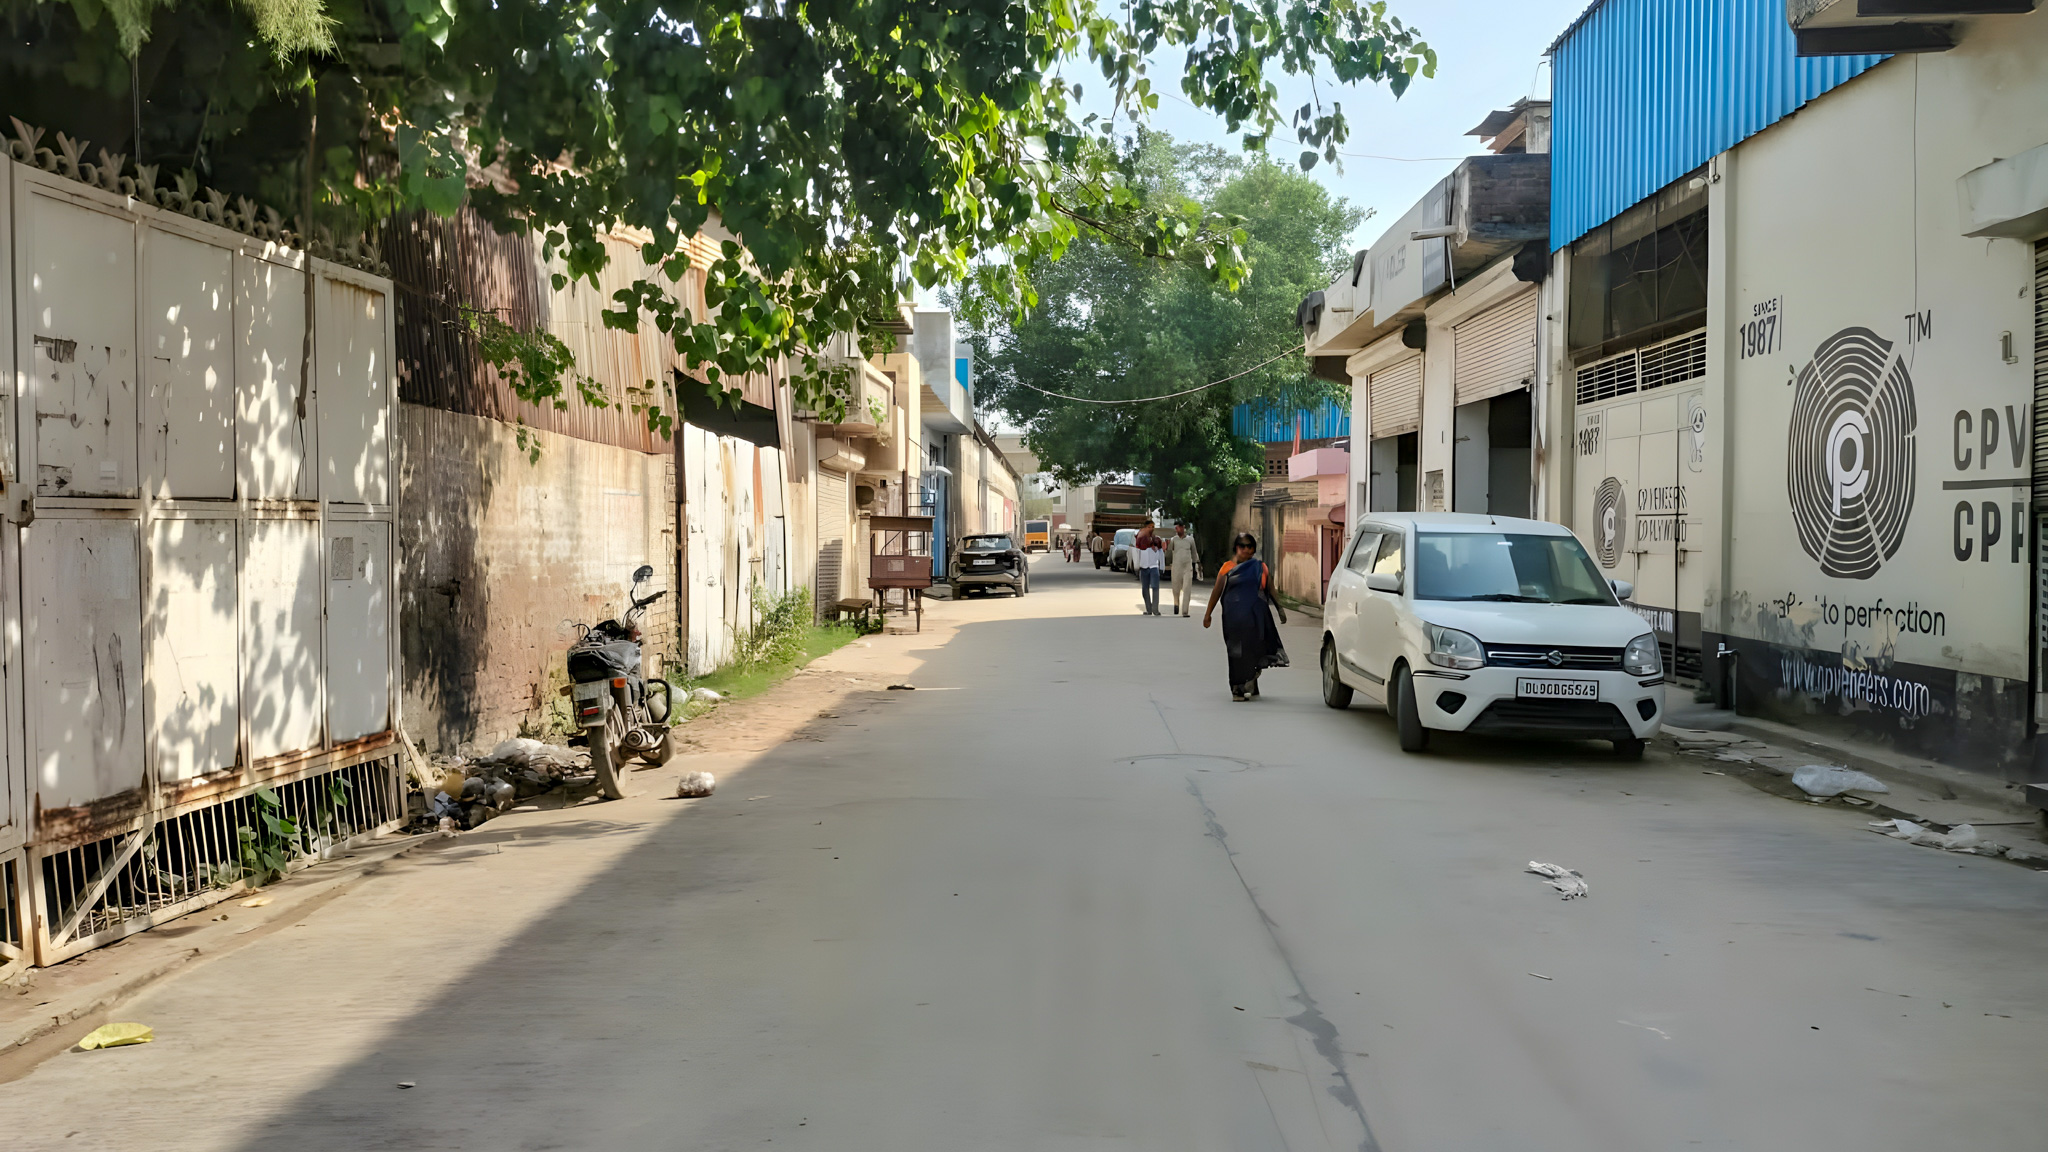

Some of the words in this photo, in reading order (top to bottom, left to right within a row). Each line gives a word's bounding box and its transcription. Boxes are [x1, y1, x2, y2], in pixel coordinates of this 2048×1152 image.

[1740, 315, 1776, 359] 1987
[1905, 309, 1932, 345] TM
[1954, 403, 2033, 471] CPV
[1821, 596, 1839, 624] to
